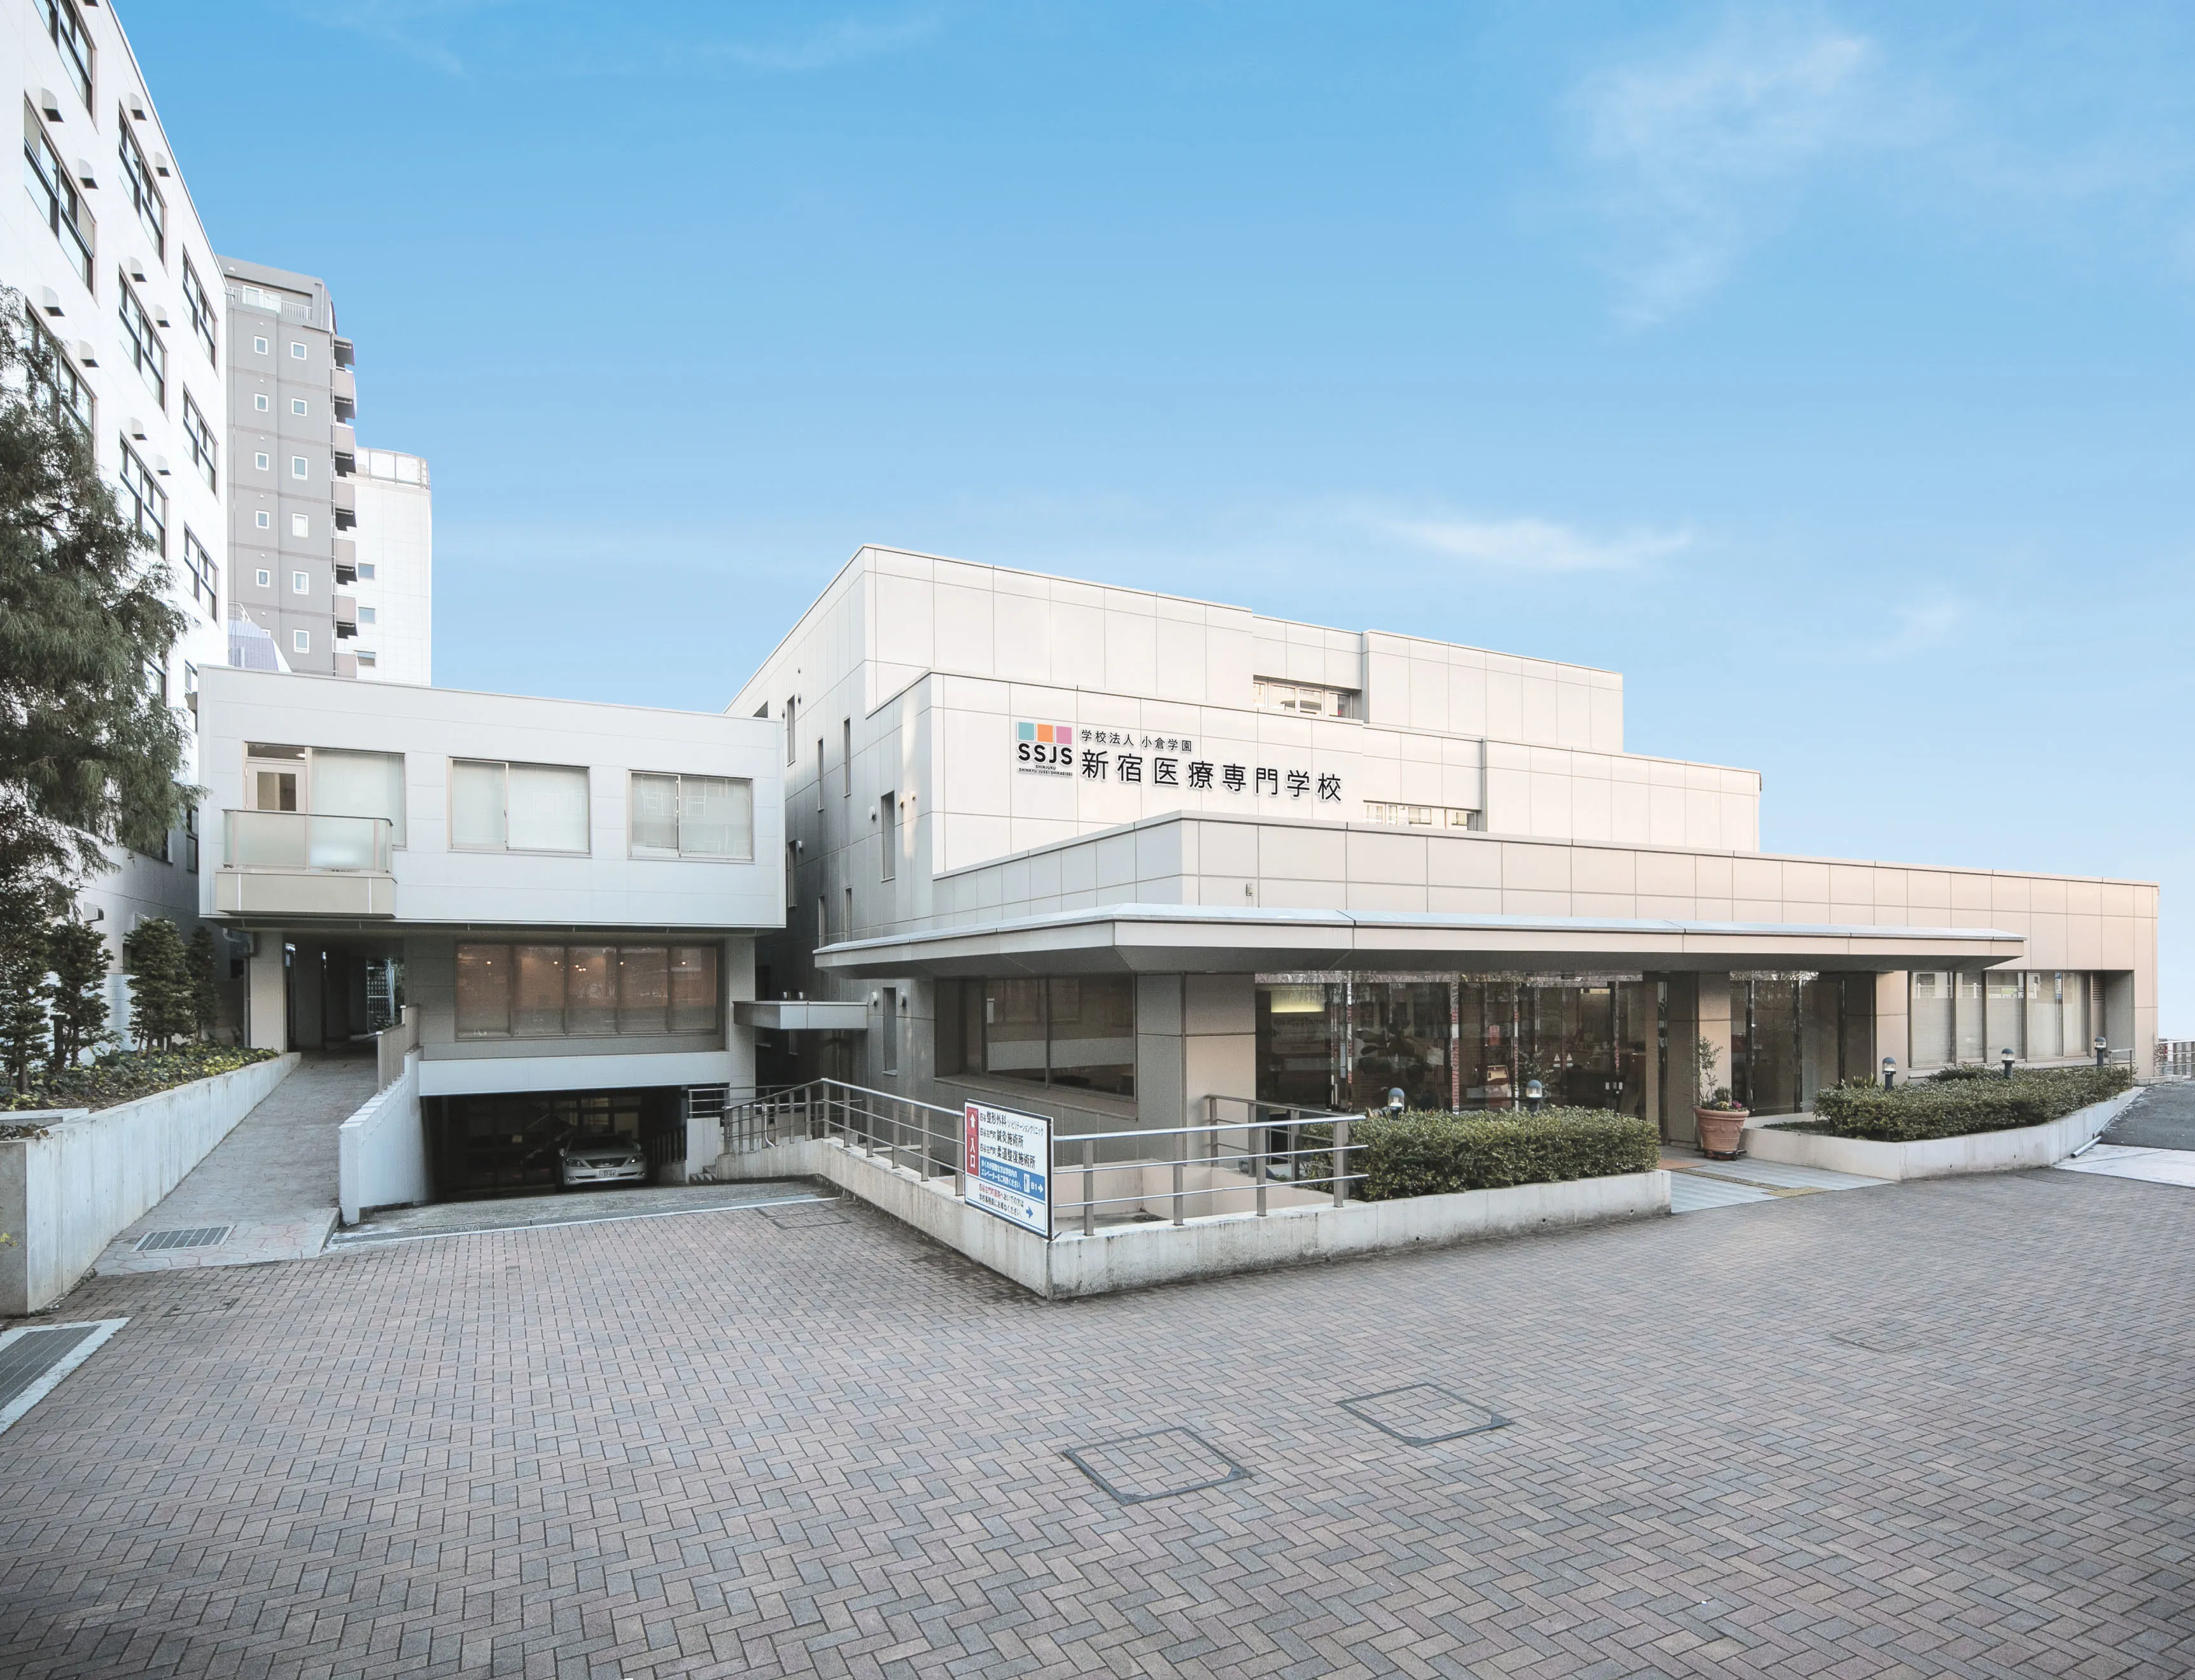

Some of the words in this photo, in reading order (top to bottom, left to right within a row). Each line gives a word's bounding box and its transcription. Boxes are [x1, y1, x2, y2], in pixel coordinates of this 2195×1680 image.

[1081, 729, 1134, 746] 学校法人
[1141, 736, 1192, 753] 小倉学園
[1018, 743, 1072, 765] SSJS
[1081, 748, 1342, 802] 新宿医療専門学校
[970, 1137, 976, 1168] 入口
[1030, 1182, 1037, 1191] B1
